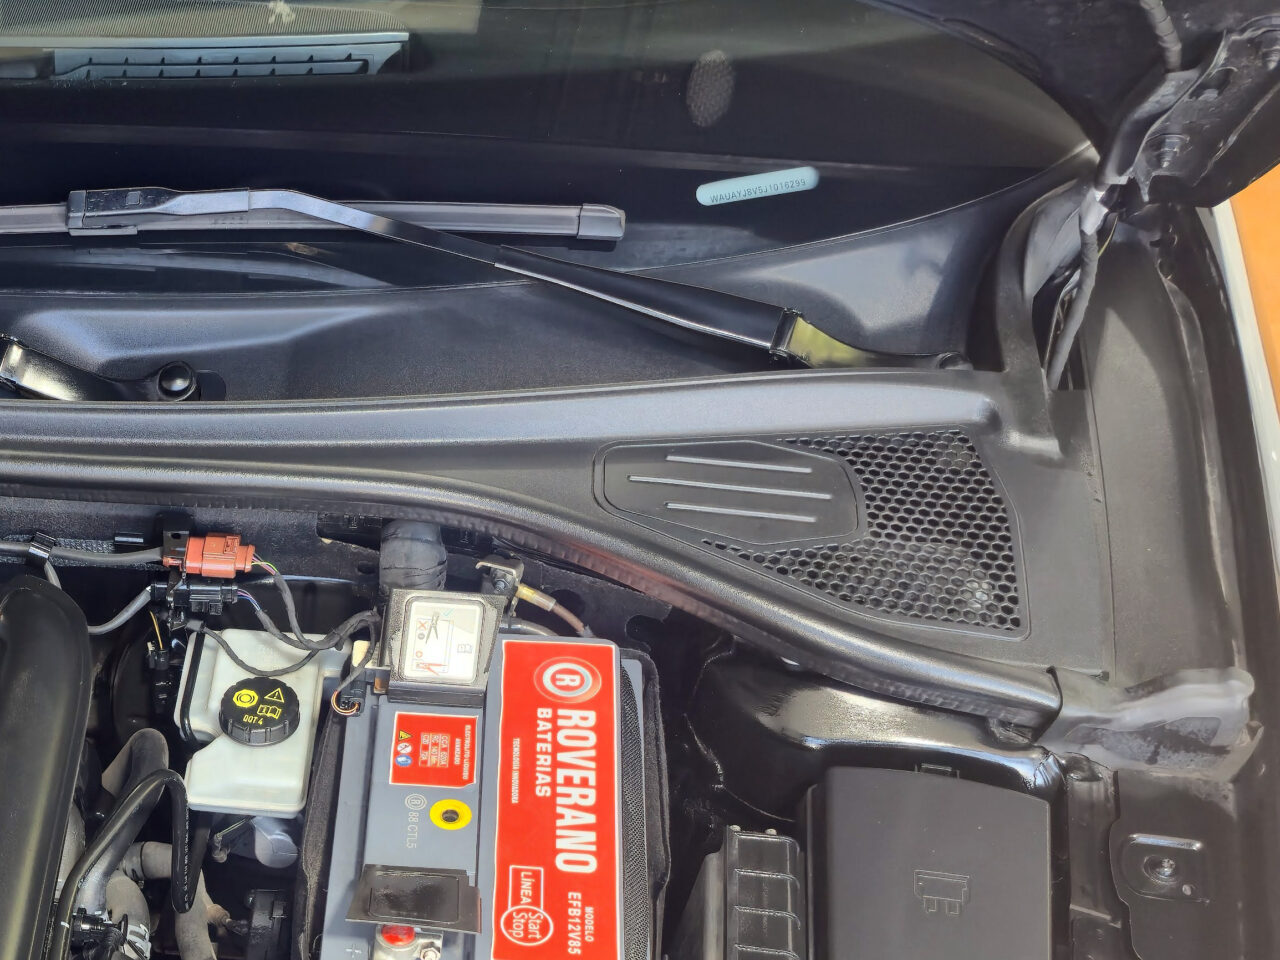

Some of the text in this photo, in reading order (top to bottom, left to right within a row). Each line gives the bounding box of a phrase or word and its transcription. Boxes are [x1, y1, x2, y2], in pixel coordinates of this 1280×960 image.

[709, 178, 807, 203] WAUAYJ8V5J1016299
[242, 714, 264, 725] DOT 4
[441, 735, 449, 748] CCA
[535, 707, 553, 798] BATERIAS
[555, 708, 598, 874] ROVERANO
[520, 871, 535, 904] LÍNEA
[508, 911, 528, 938] Stop
[528, 912, 543, 939] Start
[567, 891, 582, 955] EFB12V85
[584, 906, 595, 942] MODELO
